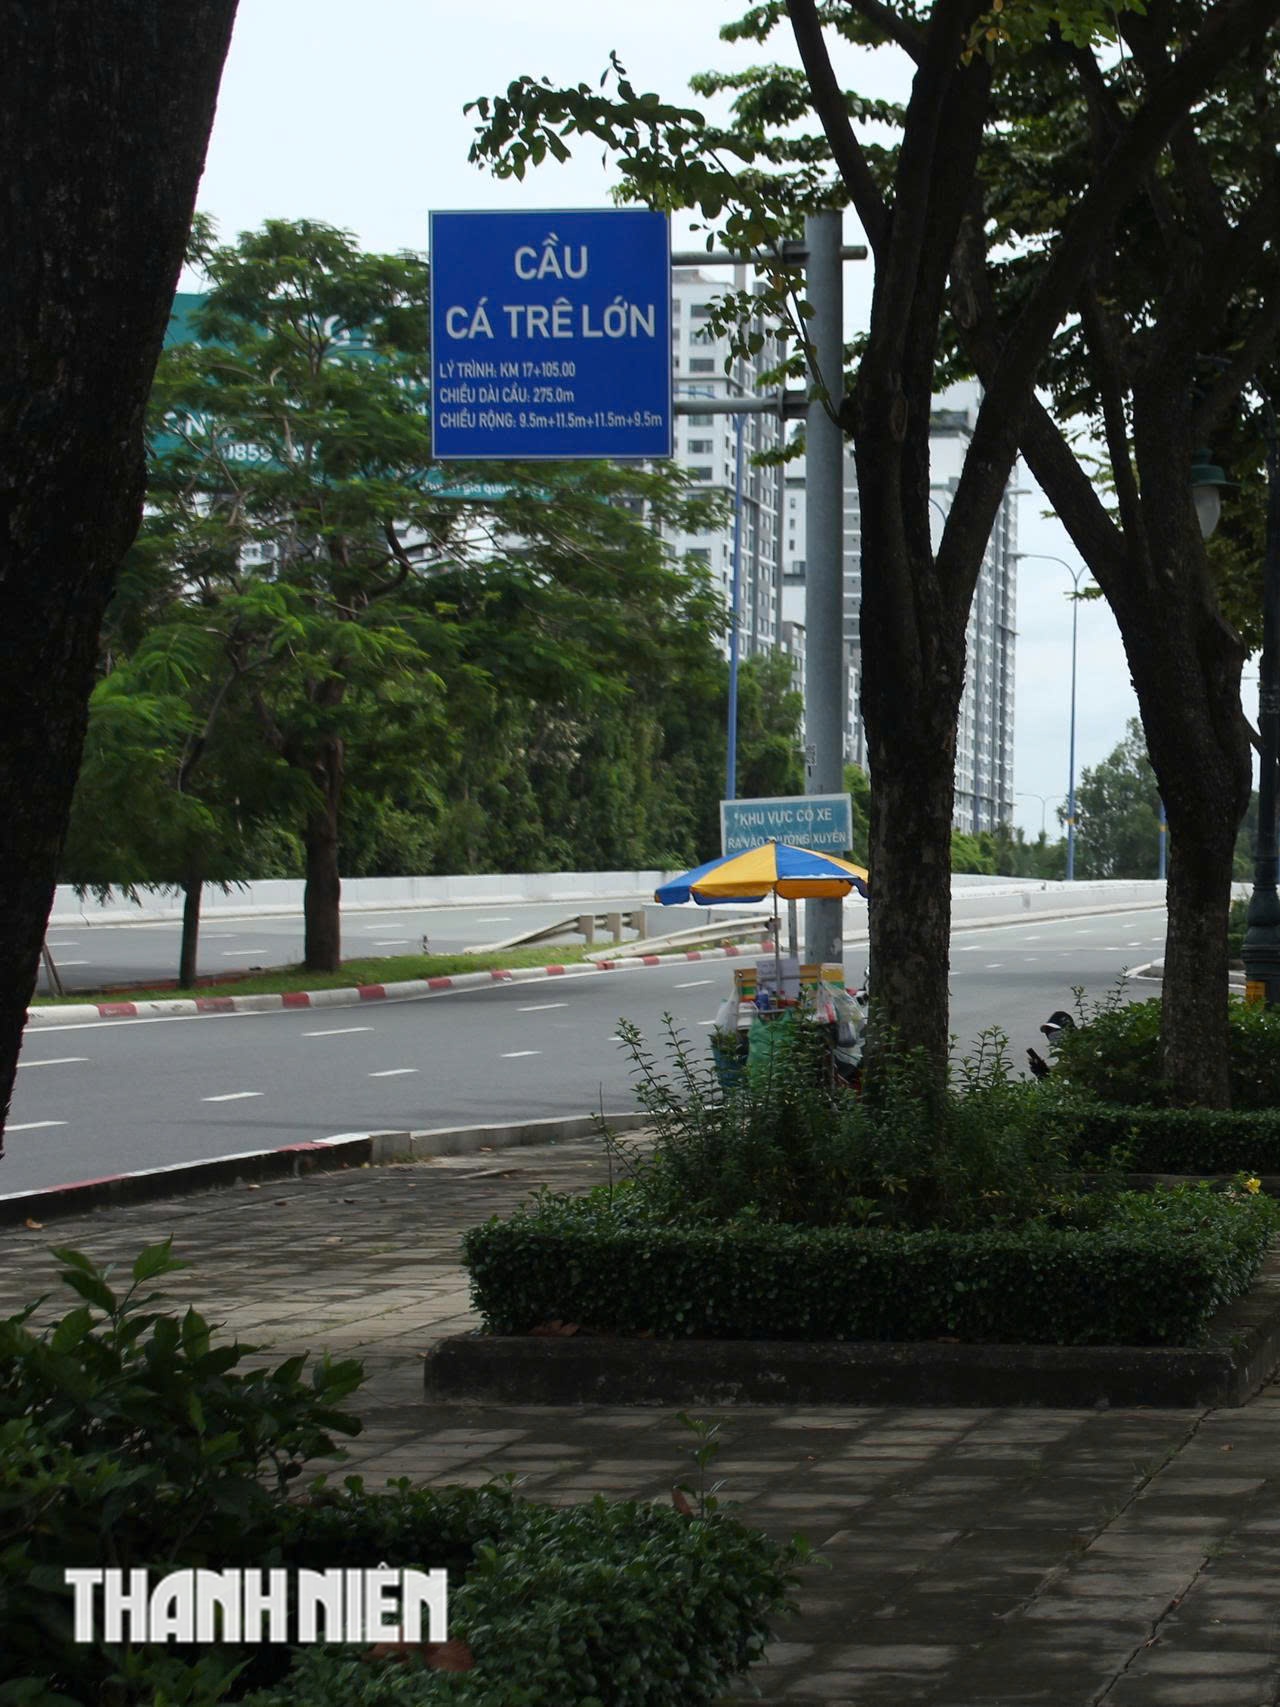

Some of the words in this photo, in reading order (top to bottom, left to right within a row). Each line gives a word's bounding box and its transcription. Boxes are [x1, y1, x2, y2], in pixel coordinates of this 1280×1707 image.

[514, 232, 588, 280] CẦU
[445, 297, 494, 340] CÁ
[503, 297, 574, 339] TRÊ
[582, 295, 655, 339] LỚN
[457, 359, 497, 378] TRÌNH:
[500, 362, 519, 378] KM
[523, 361, 576, 378] 17+105.00
[479, 384, 499, 402] DÀI
[533, 386, 575, 402] 275.0m
[479, 409, 516, 431] RỘNG:
[739, 811, 764, 826] KHU
[816, 807, 832, 820] XE
